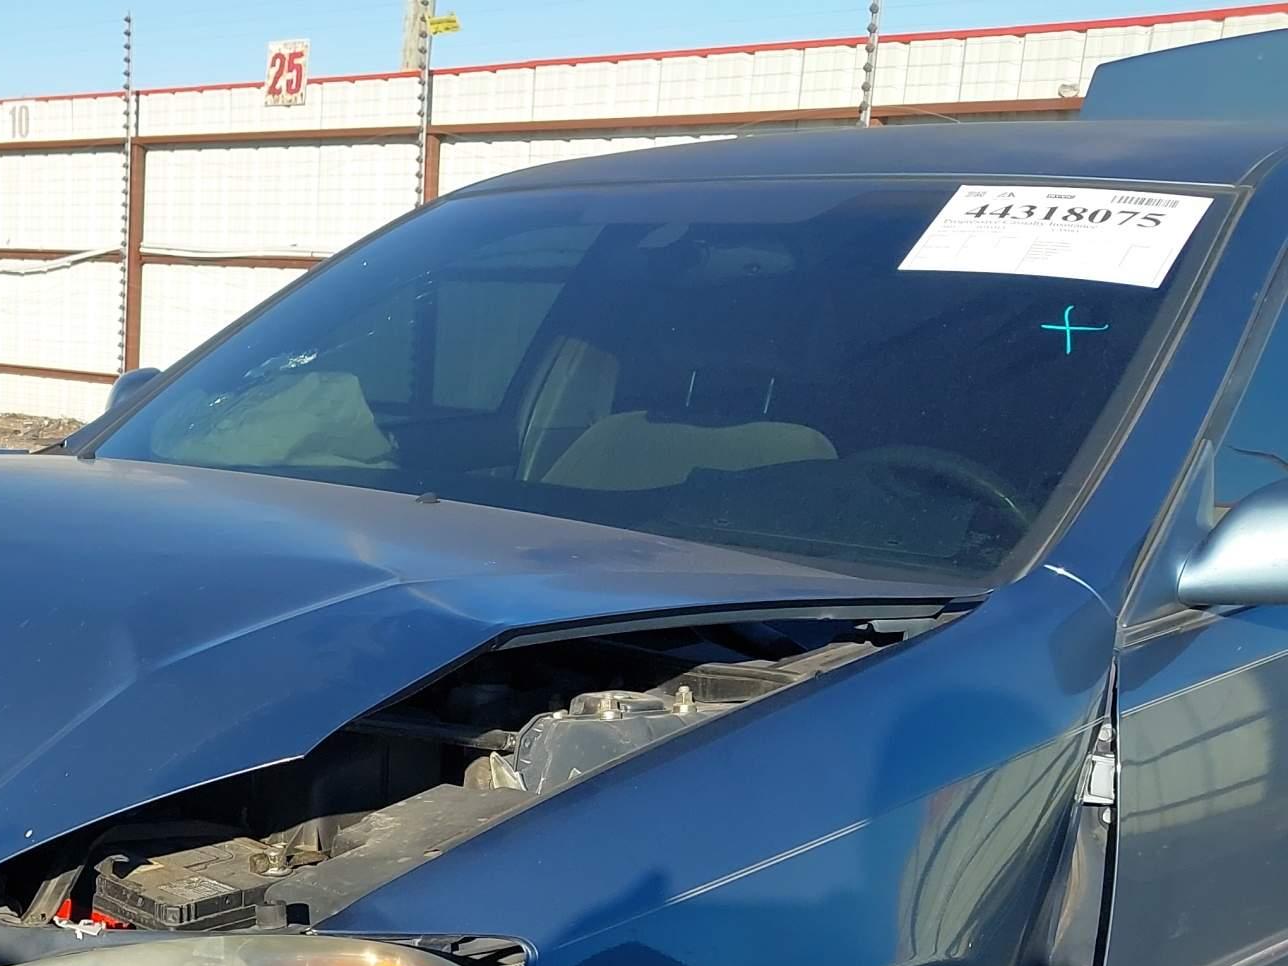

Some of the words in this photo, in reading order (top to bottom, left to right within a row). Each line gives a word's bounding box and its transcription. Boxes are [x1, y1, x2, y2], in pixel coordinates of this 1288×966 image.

[268, 51, 304, 94] 25
[9, 105, 29, 138] 10
[964, 203, 1166, 229] 44318075
